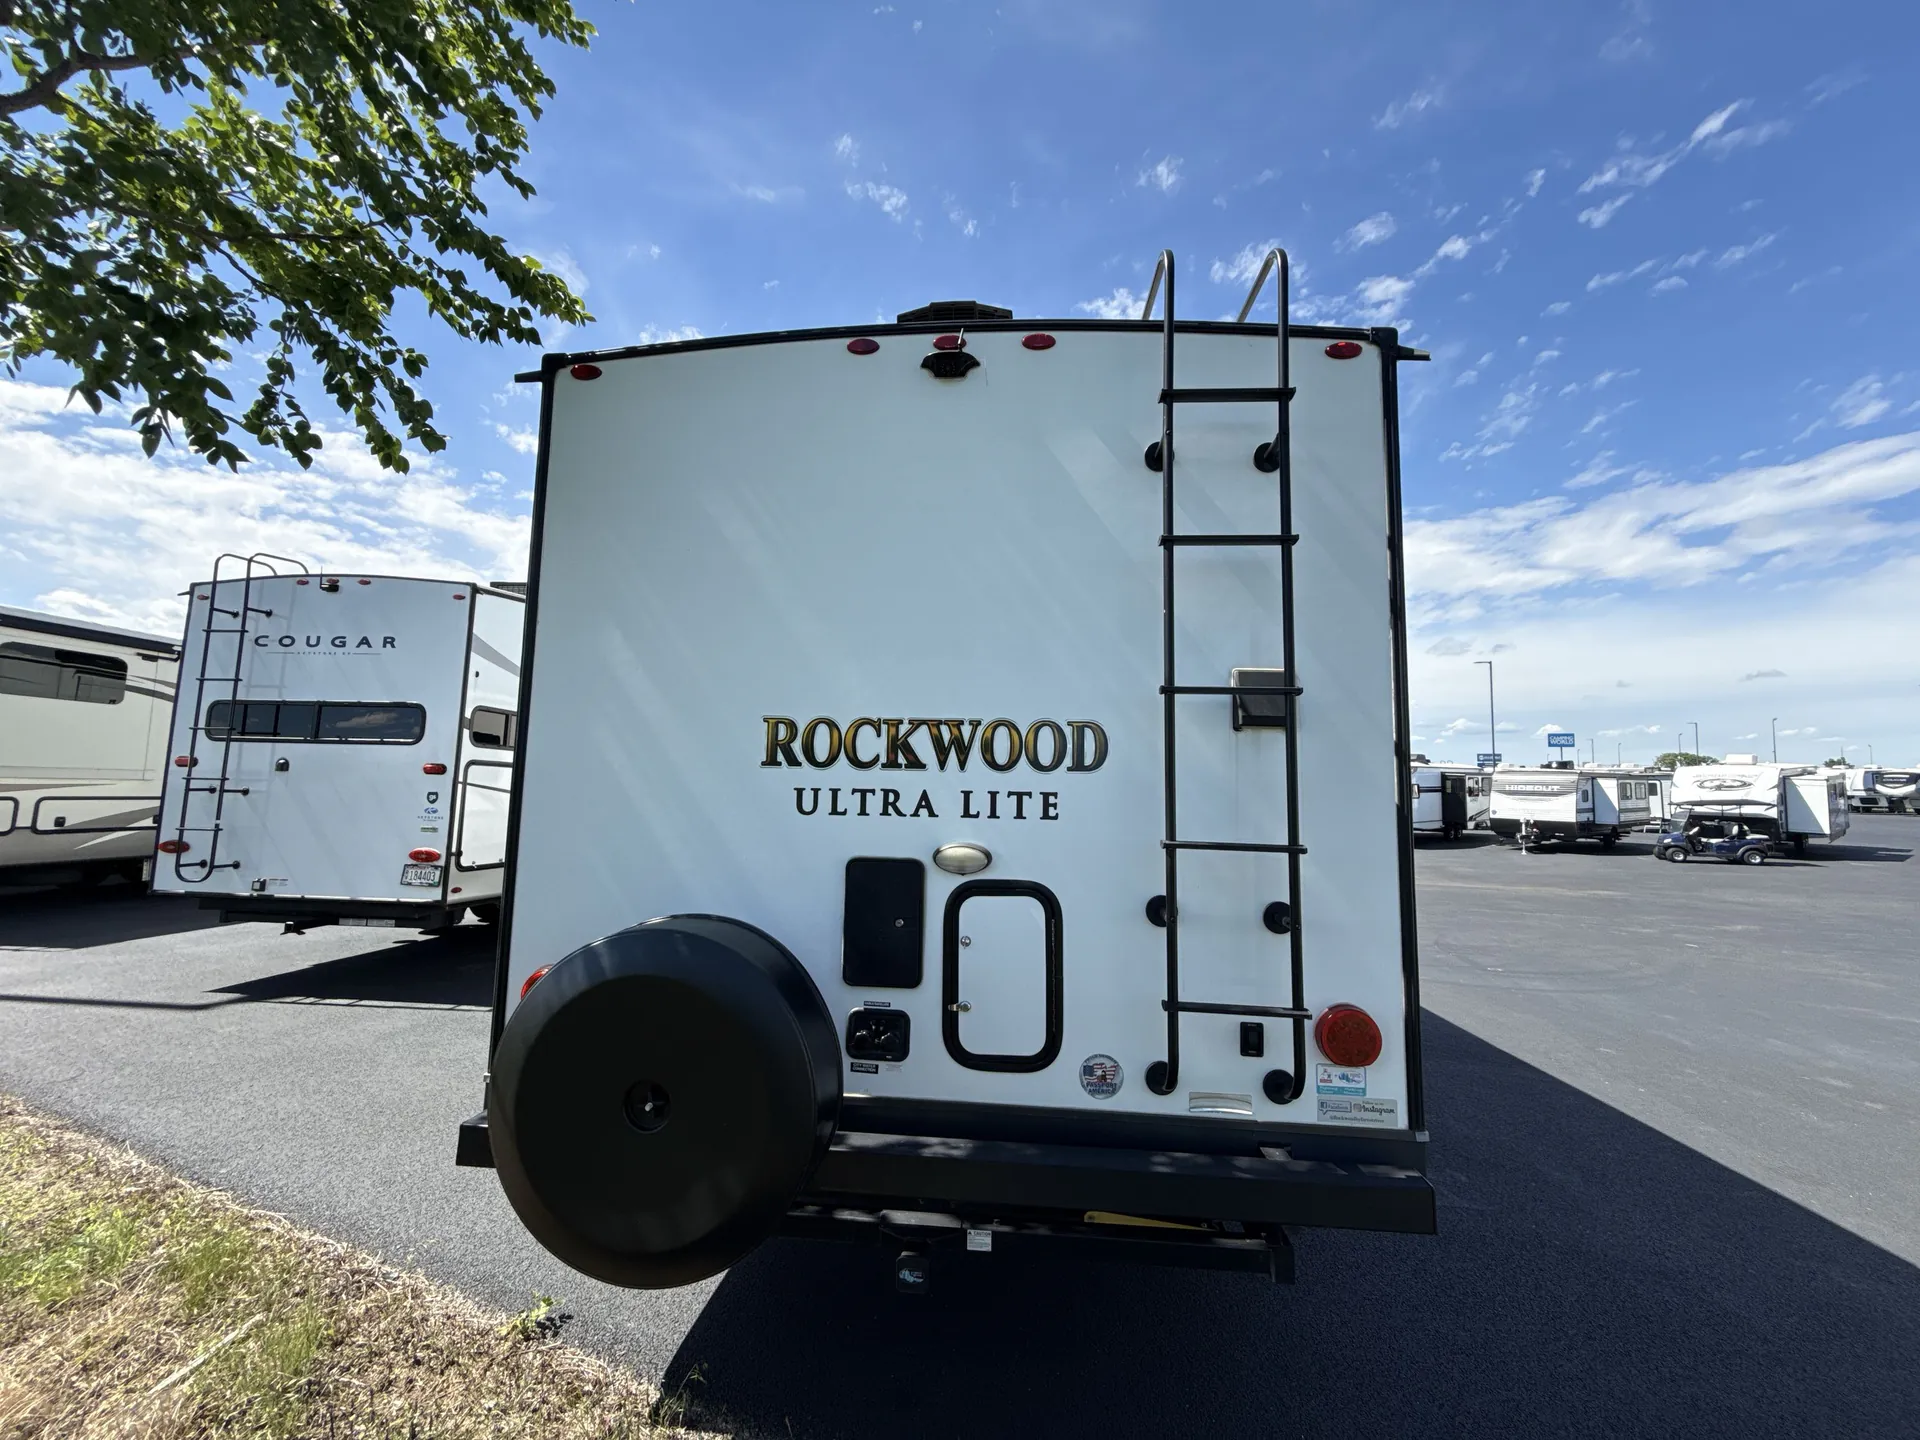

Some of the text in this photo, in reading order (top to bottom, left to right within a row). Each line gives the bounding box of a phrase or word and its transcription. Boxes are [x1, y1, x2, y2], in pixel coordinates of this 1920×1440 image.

[254, 635, 396, 648] COUGAR
[760, 717, 1109, 772] ROCKWOOD
[794, 787, 1060, 820] ULTRA LITE
[409, 870, 436, 882] 184403
[1086, 1081, 1117, 1089] PASSPORT
[1362, 1104, 1395, 1116] Instagram
